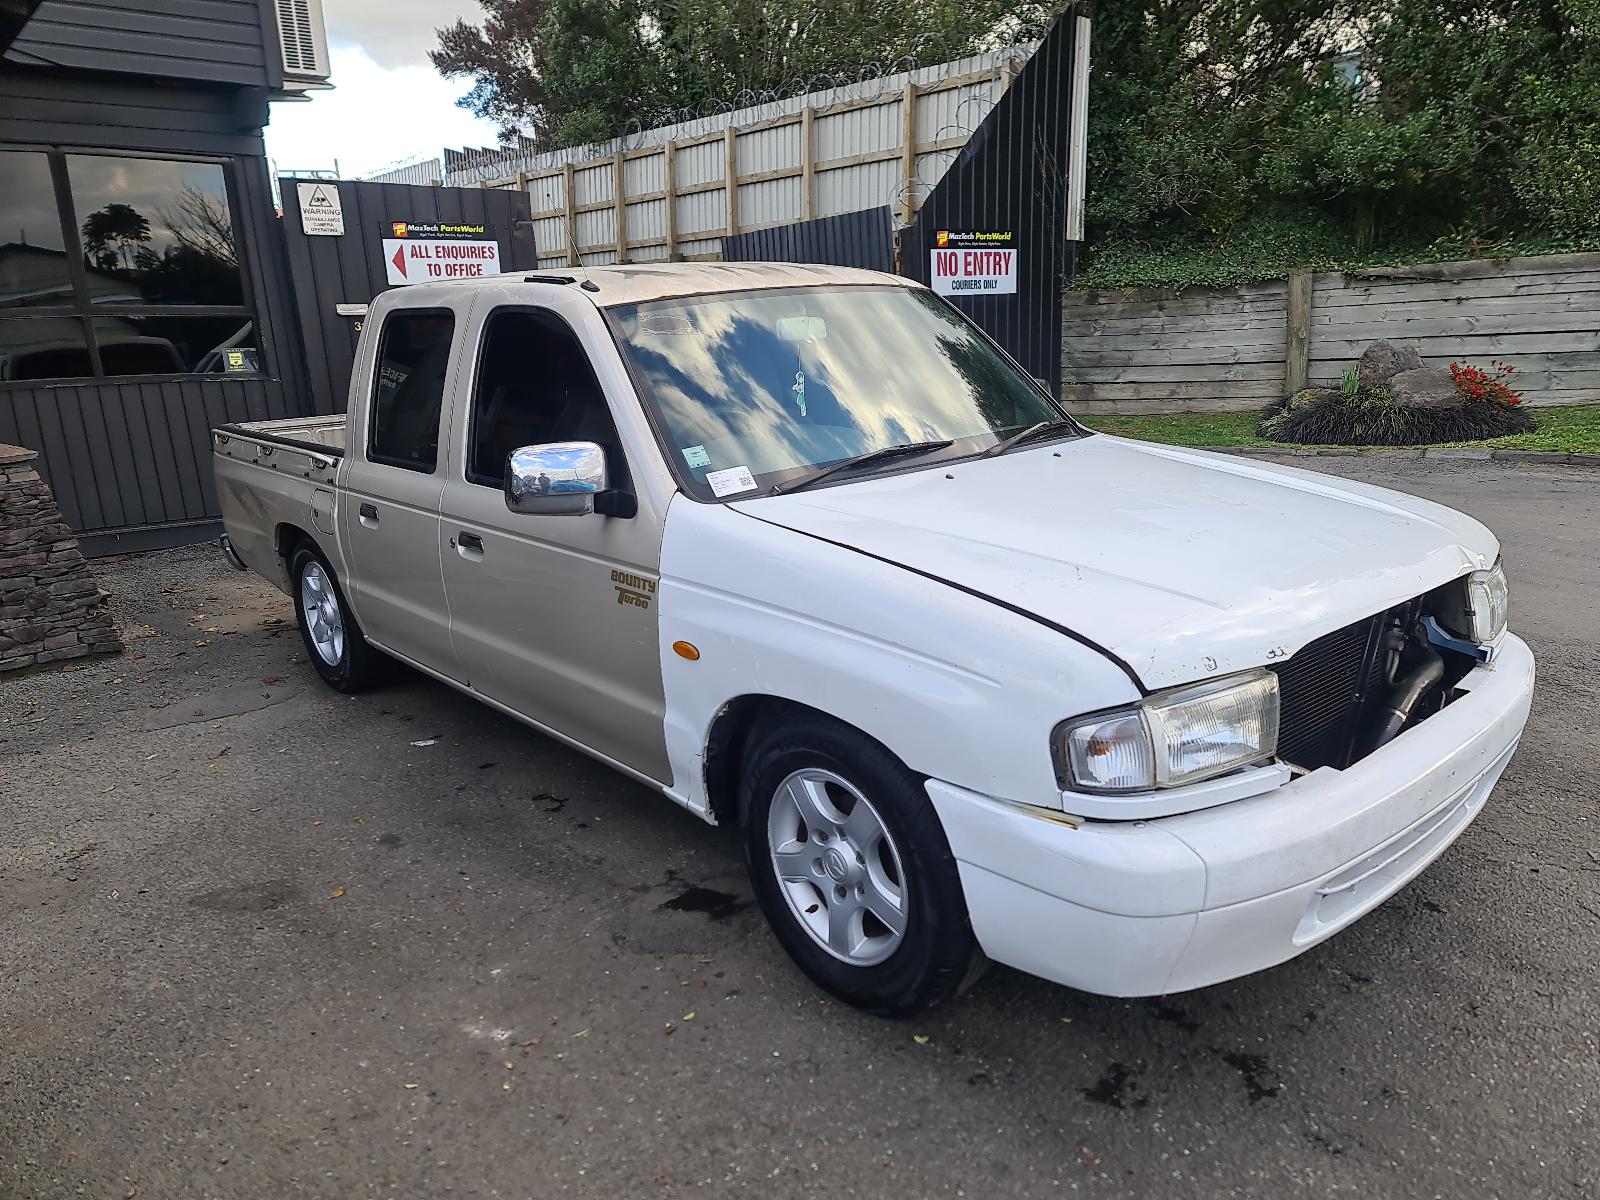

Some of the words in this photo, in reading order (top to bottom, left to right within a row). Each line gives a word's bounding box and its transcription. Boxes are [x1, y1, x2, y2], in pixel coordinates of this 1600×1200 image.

[303, 207, 341, 215] WARNING
[440, 225, 484, 233] PartsWorld
[975, 232, 1012, 240] PartsWorld
[410, 245, 432, 259] ALL
[435, 245, 495, 260] ENQUIRIES
[936, 251, 959, 277] NO
[964, 251, 1012, 277] ENTRY
[427, 264, 442, 277] TO
[445, 264, 483, 277] OFFICE
[951, 279, 982, 290] COURIERS
[983, 279, 998, 289] ONLY
[611, 569, 656, 593] BOUNTY
